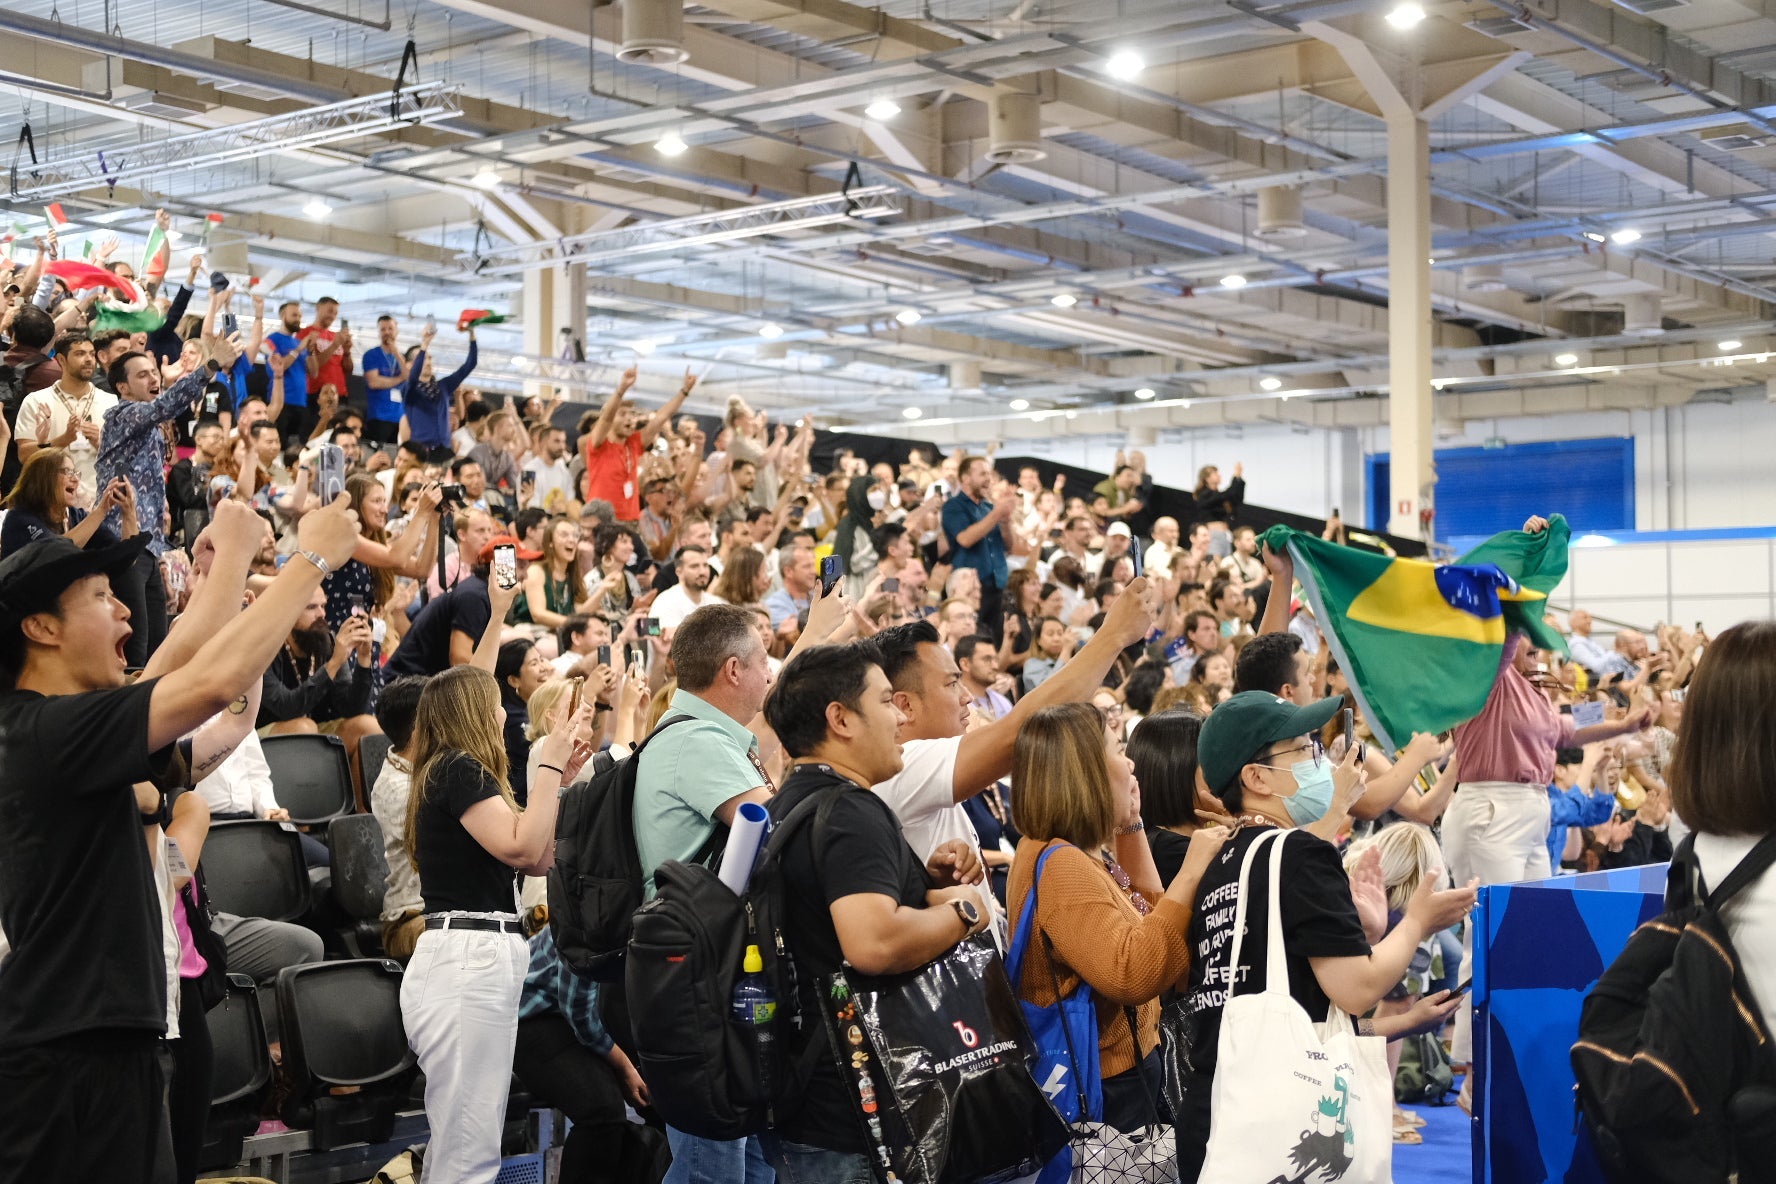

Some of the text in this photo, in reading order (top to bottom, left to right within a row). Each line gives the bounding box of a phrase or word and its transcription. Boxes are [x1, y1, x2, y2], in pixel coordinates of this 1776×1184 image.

[1201, 881, 1239, 911] COFFEE
[1205, 905, 1236, 933] FAMILY
[934, 1040, 1018, 1074] BLASER TRADING
[968, 1058, 993, 1073] SUISSE
[1293, 1070, 1322, 1087] COFFEE
